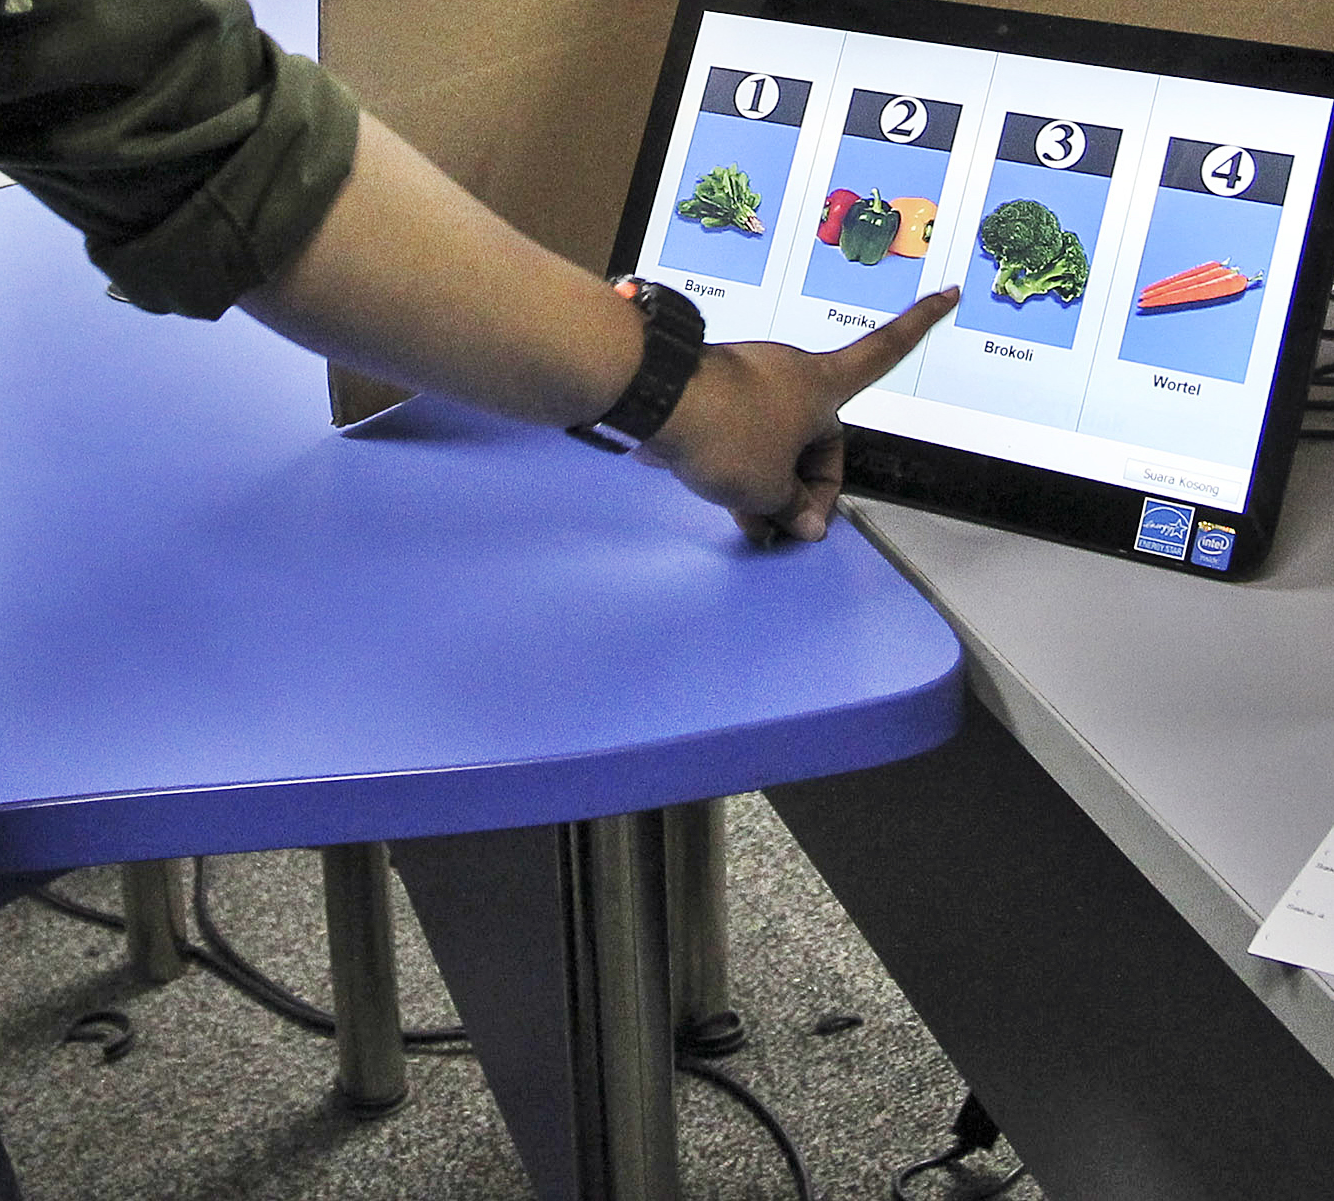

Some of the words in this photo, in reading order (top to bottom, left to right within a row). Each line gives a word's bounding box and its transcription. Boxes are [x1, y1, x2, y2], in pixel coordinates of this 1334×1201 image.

[886, 99, 918, 138] 2
[1042, 124, 1075, 162] 3
[1211, 151, 1244, 189] 4
[684, 279, 726, 299] Bayam
[827, 308, 877, 330] Paprika
[984, 340, 1034, 362] Brokoli
[1153, 374, 1202, 396] Wortel
[1143, 468, 1175, 485] Suara
[1179, 476, 1220, 497] Kosong
[1202, 534, 1226, 551] intel
